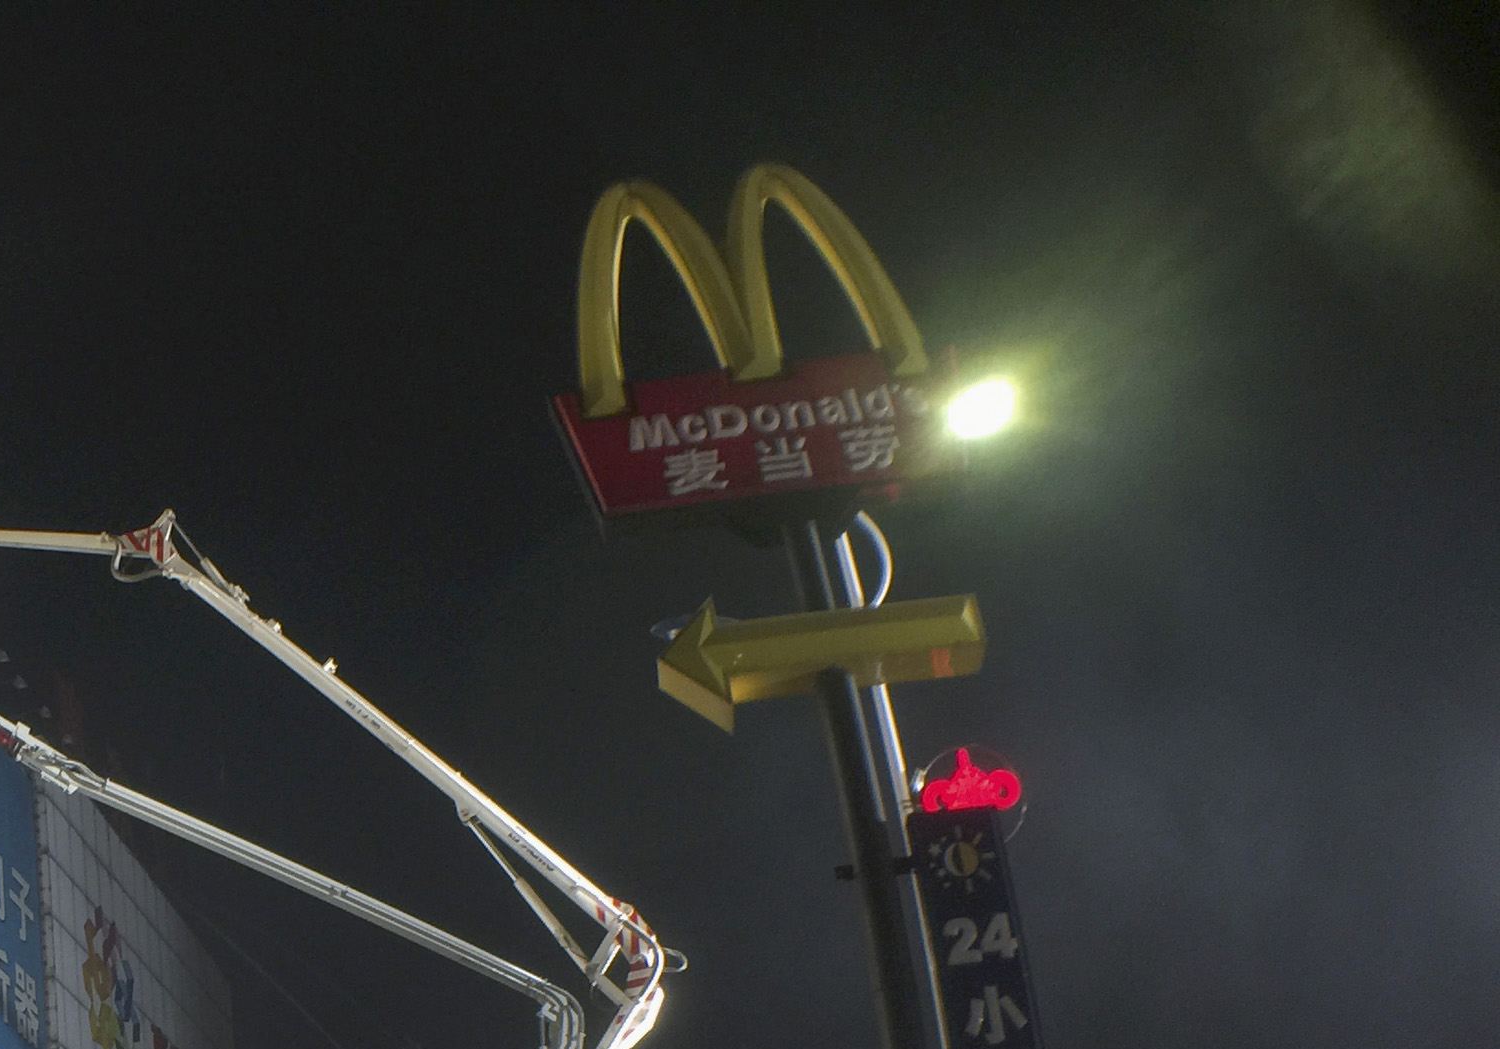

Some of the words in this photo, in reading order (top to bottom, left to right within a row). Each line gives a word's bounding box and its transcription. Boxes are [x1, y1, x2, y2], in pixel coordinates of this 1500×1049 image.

[628, 383, 930, 452] McDonald's
[663, 426, 899, 496] 麦当劳
